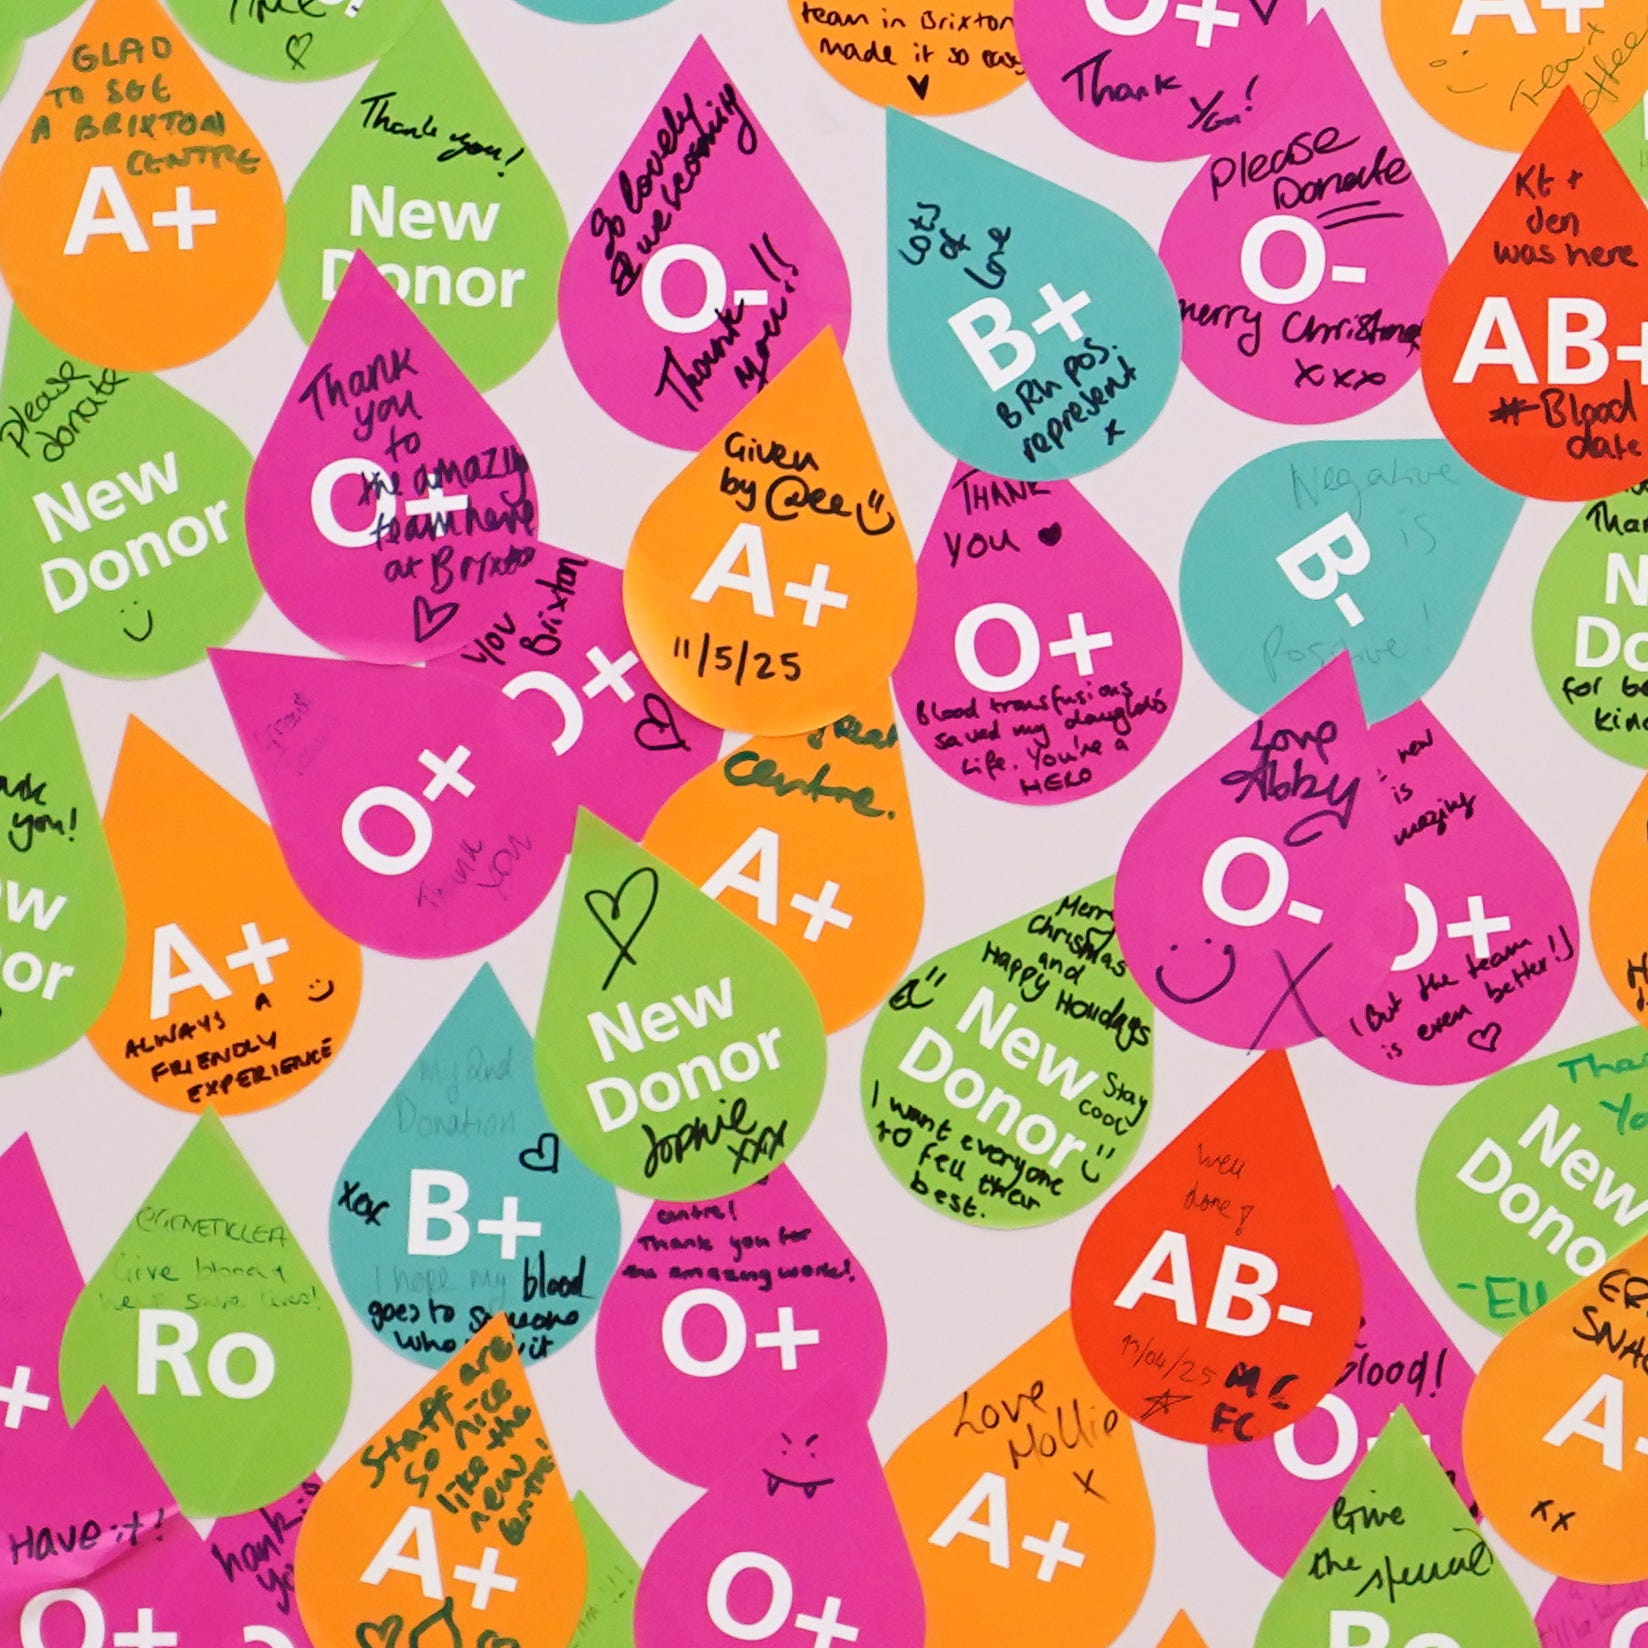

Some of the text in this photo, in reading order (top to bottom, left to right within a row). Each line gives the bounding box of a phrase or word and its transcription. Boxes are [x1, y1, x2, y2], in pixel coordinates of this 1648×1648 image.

[72, 36, 173, 73] GLAD
[1063, 51, 1180, 110] Thank
[62, 166, 218, 259] A+
[1494, 238, 1639, 269] was here
[947, 282, 1093, 393] B+
[298, 348, 420, 425] Thank
[32, 450, 183, 544] New
[39, 495, 232, 618] Donor
[689, 523, 851, 630] A+
[672, 635, 802, 684] 11/5/25
[953, 601, 1114, 695] O+
[151, 1031, 278, 1082] FRIENDLY
[587, 975, 735, 1063] New
[186, 1037, 333, 1104] EXPERIENCE
[585, 1022, 783, 1134] Donor
[406, 1169, 543, 1260] B+
[522, 1256, 595, 1302] blood
[1114, 1229, 1315, 1338] AB-
[135, 1308, 276, 1399] Ro
[954, 1380, 1047, 1439] Love
